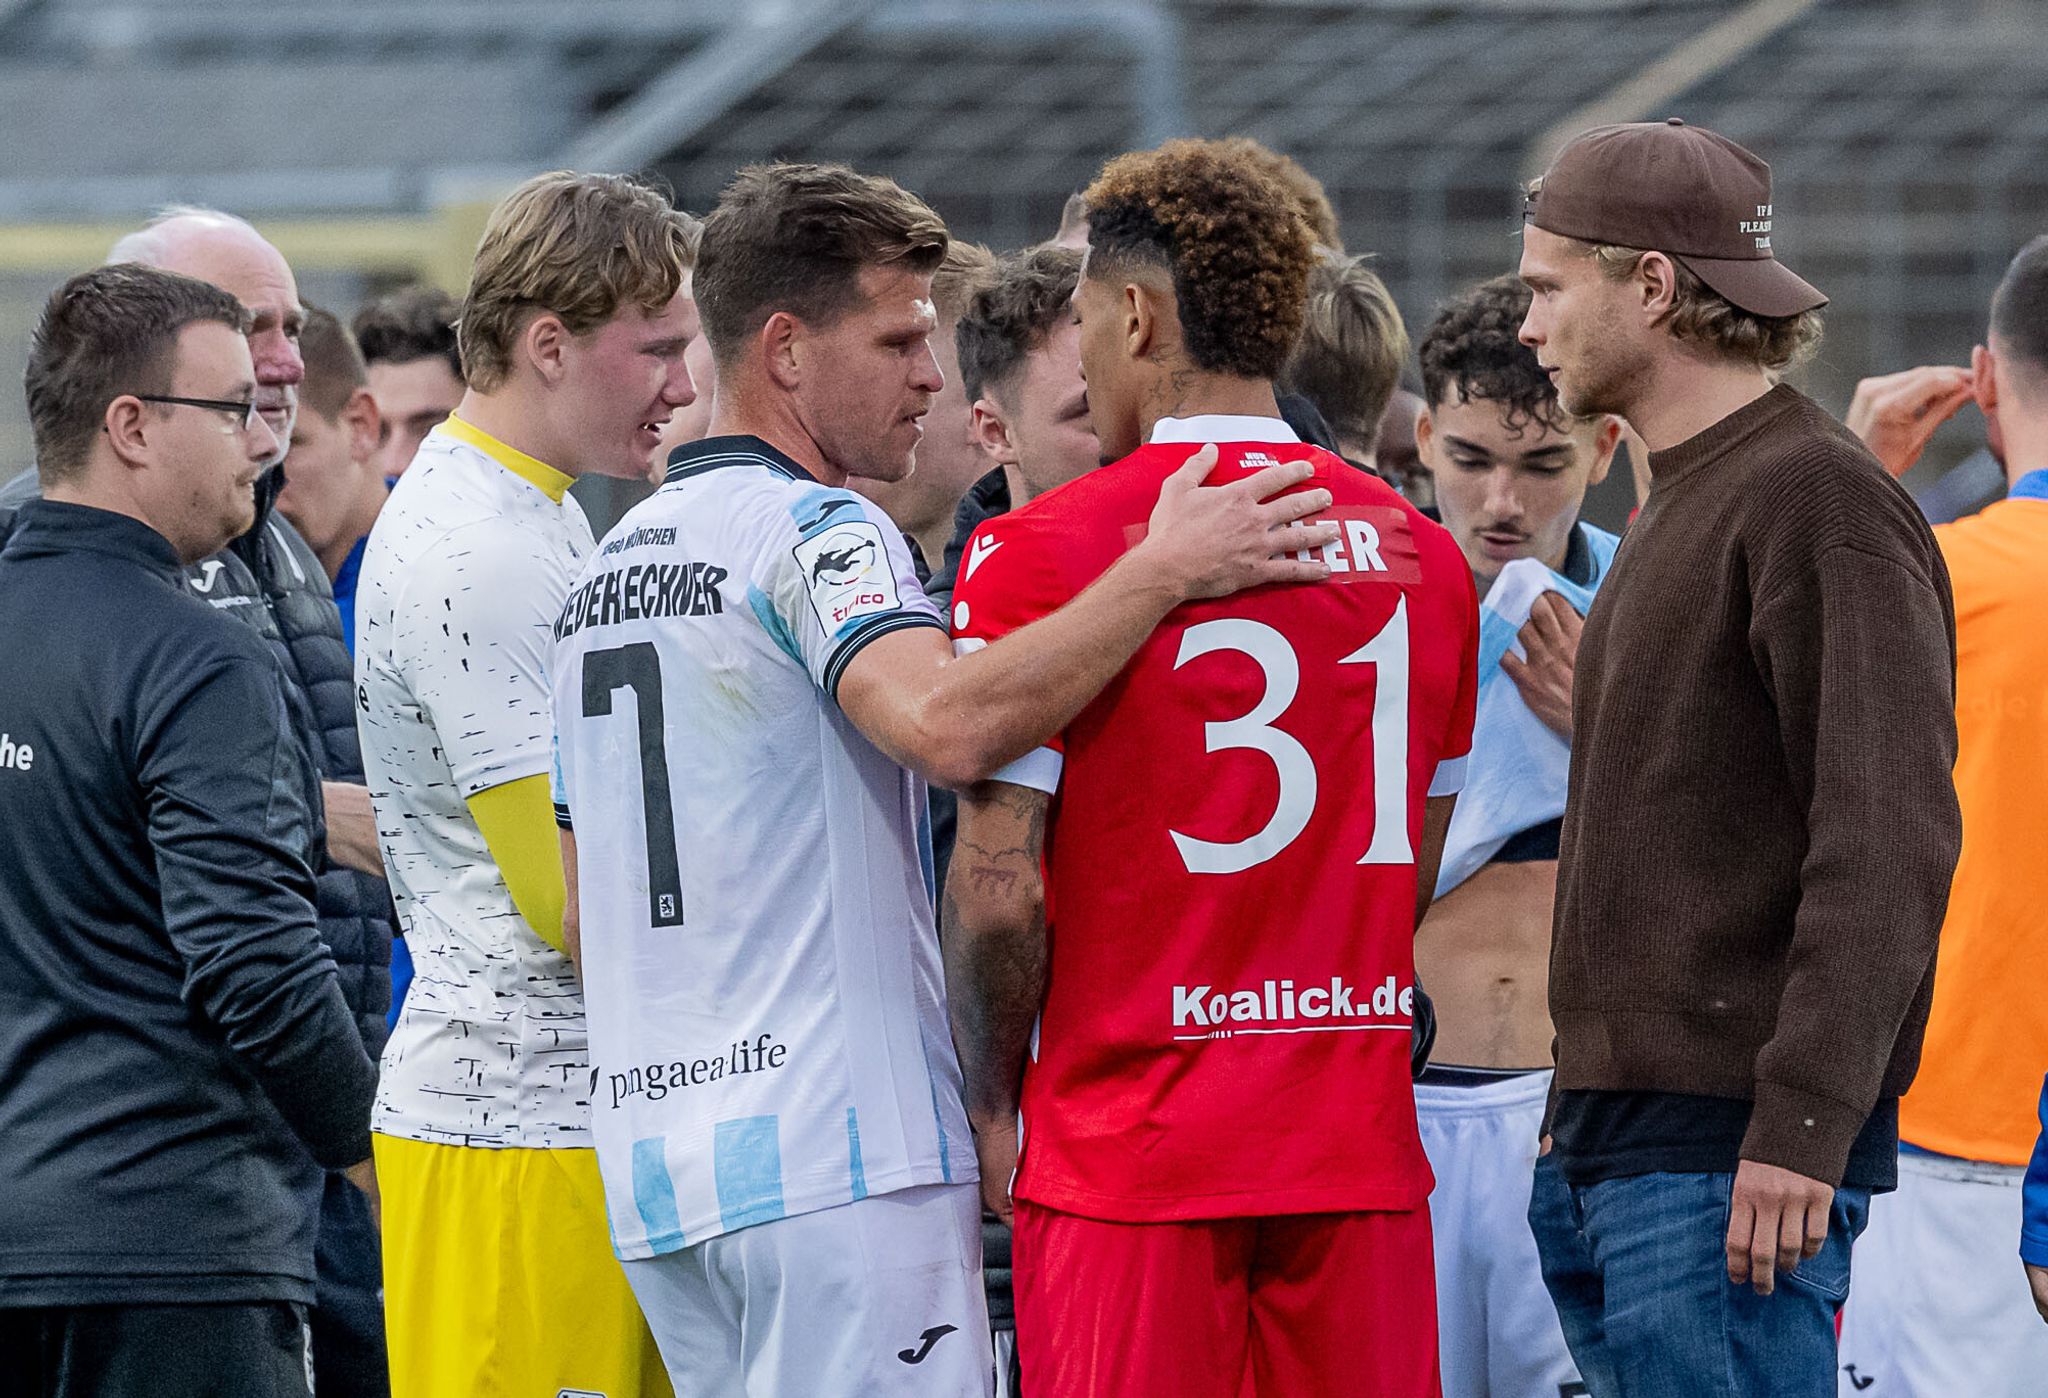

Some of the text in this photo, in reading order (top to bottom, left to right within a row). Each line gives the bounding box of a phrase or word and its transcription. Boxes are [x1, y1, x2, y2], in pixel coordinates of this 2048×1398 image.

[1740, 221, 1772, 233] PLEAS
[1756, 205, 1767, 217] IF
[0, 733, 34, 771] he
[1168, 591, 1415, 874] 31
[582, 641, 684, 927] 7
[1172, 976, 1413, 1026] Koalick.de
